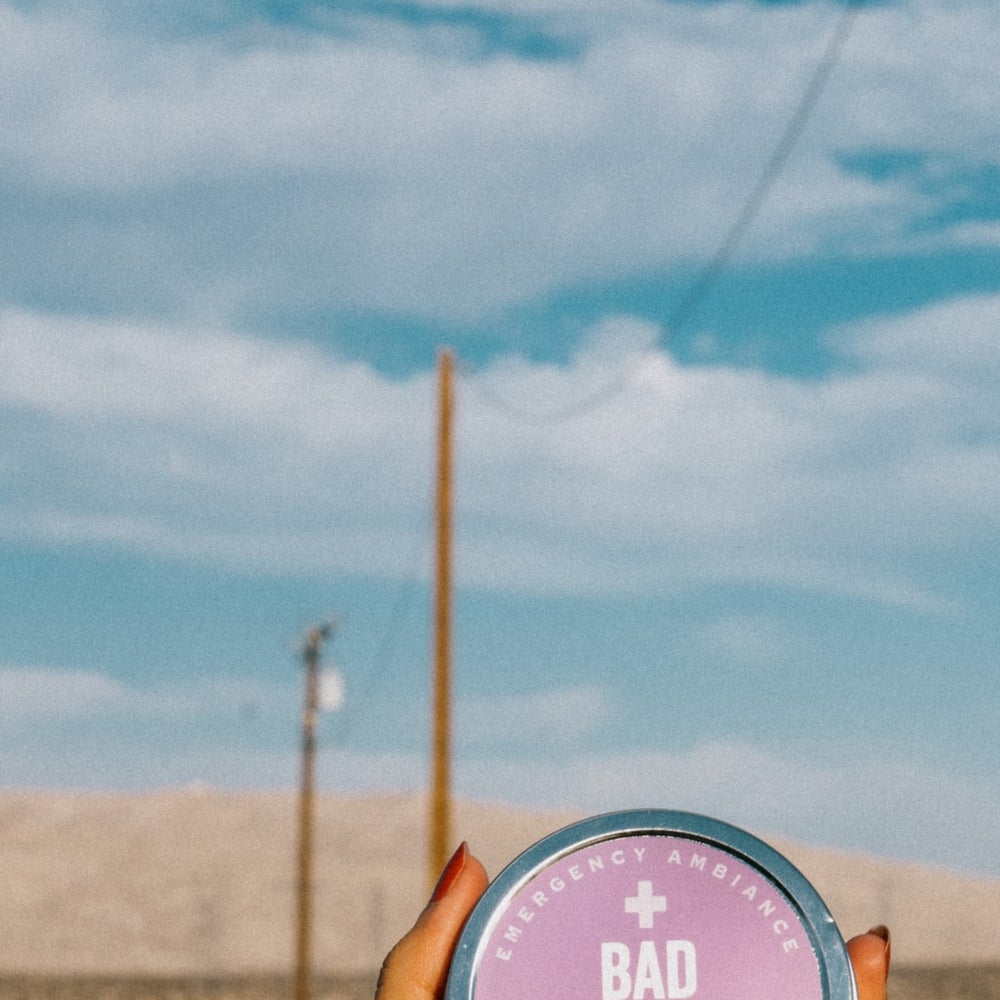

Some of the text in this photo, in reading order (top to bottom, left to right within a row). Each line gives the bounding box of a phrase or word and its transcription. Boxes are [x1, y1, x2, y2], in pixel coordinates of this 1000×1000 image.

[497, 848, 799, 961] EMERGENCY AMBIANCE
[600, 940, 697, 1000] BAD
